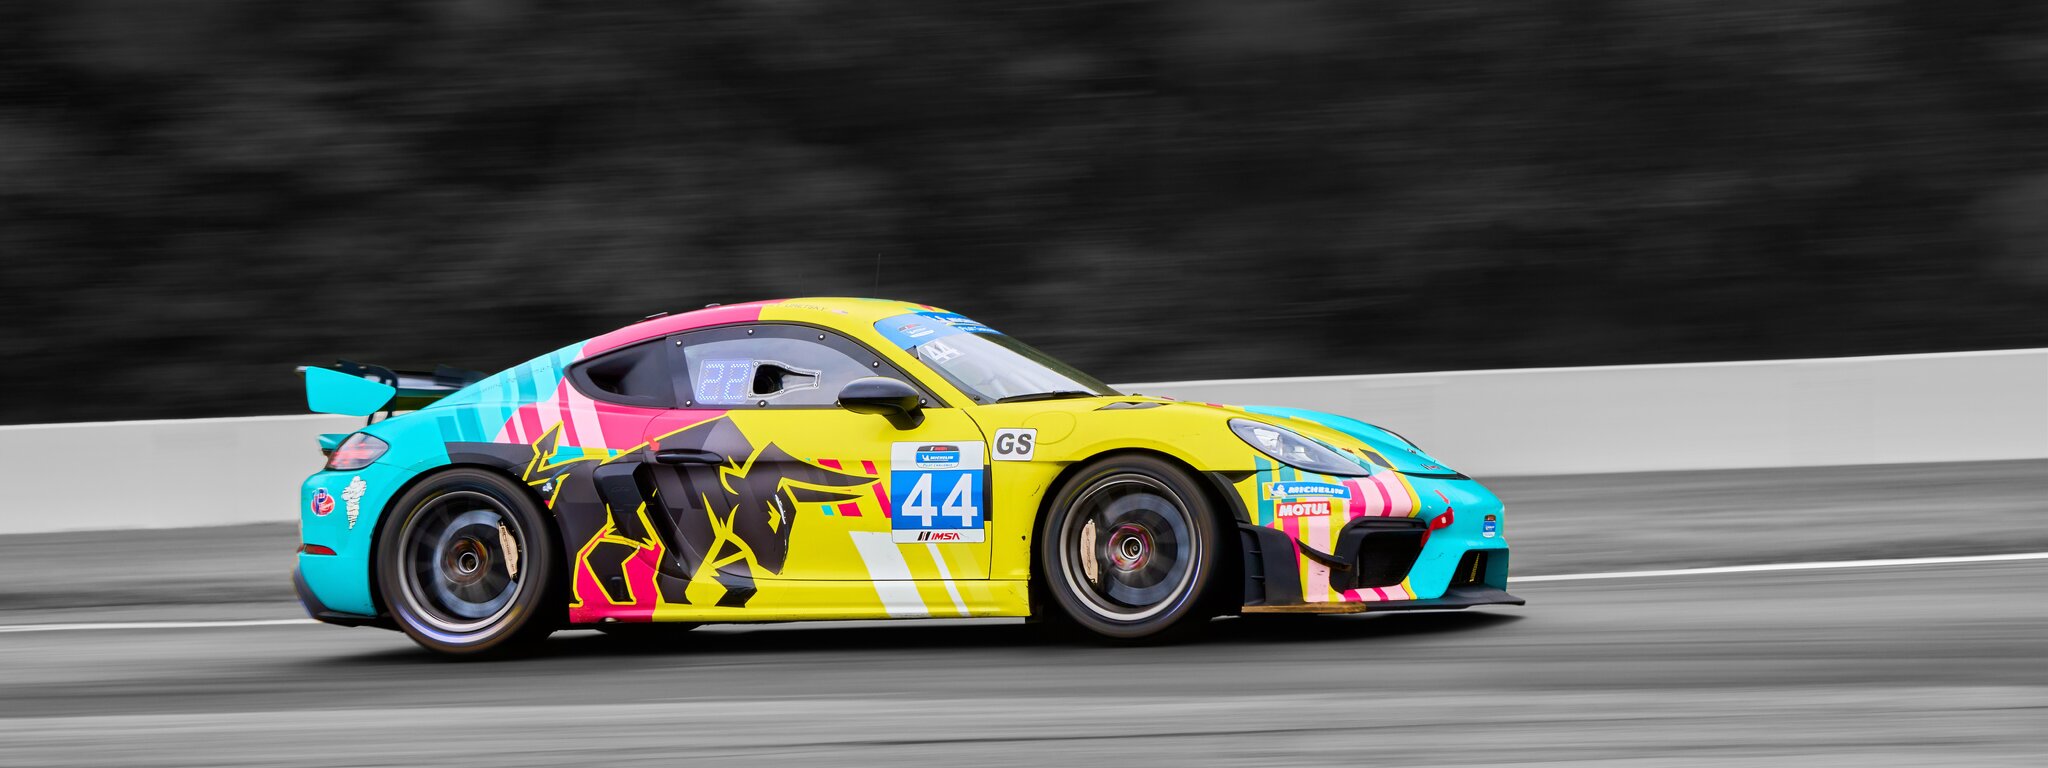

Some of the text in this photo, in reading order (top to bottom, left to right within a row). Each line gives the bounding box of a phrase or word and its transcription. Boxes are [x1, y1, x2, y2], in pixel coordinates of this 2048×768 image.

[925, 341, 965, 361] 44
[699, 364, 749, 400] 22
[996, 432, 1032, 455] GS
[901, 473, 978, 527] 44
[1287, 486, 1344, 495] MICHELIN
[1278, 503, 1330, 517] MOTUL
[931, 532, 960, 541] IMSA
